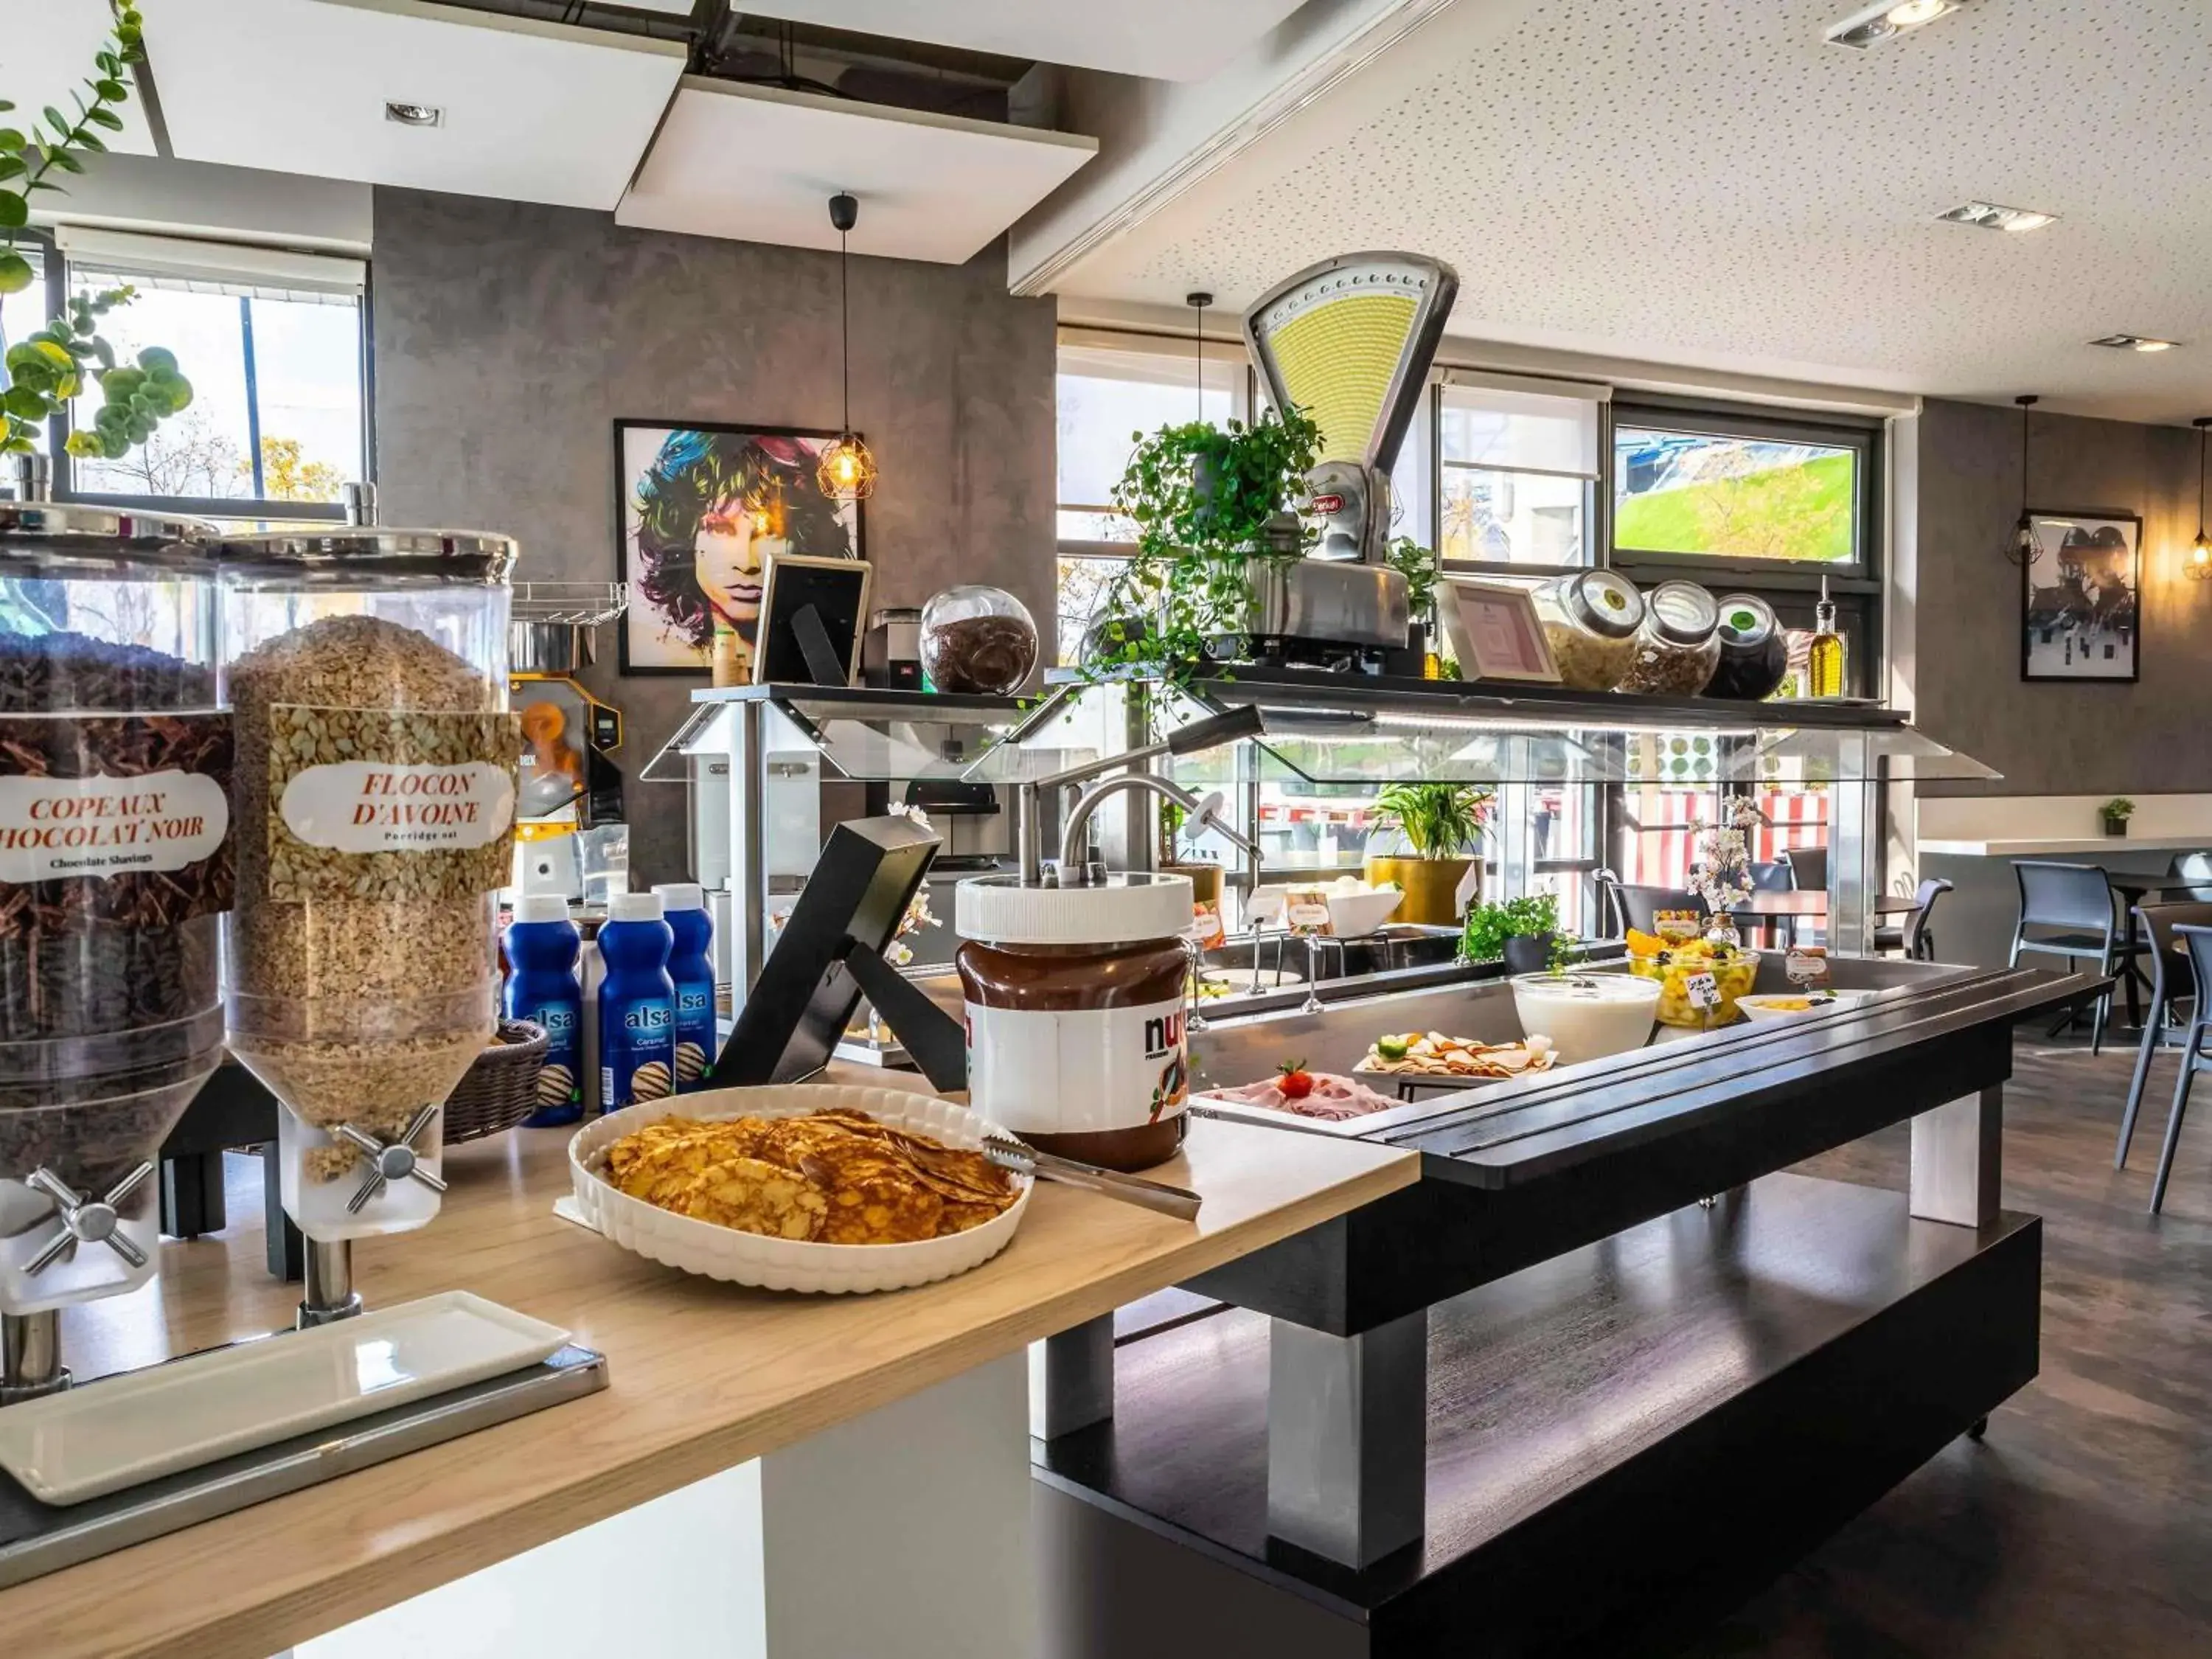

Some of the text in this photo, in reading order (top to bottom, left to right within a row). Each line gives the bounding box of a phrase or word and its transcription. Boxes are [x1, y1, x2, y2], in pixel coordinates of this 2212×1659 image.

[361, 773, 476, 796] FLOCON
[29, 793, 166, 820] COPEAUX
[352, 801, 480, 825] D'AVOINE
[145, 815, 204, 843] NOIR
[384, 830, 457, 841] Porridge oat
[50, 853, 153, 869] Chocolate Shavings
[626, 1006, 672, 1027] alsa
